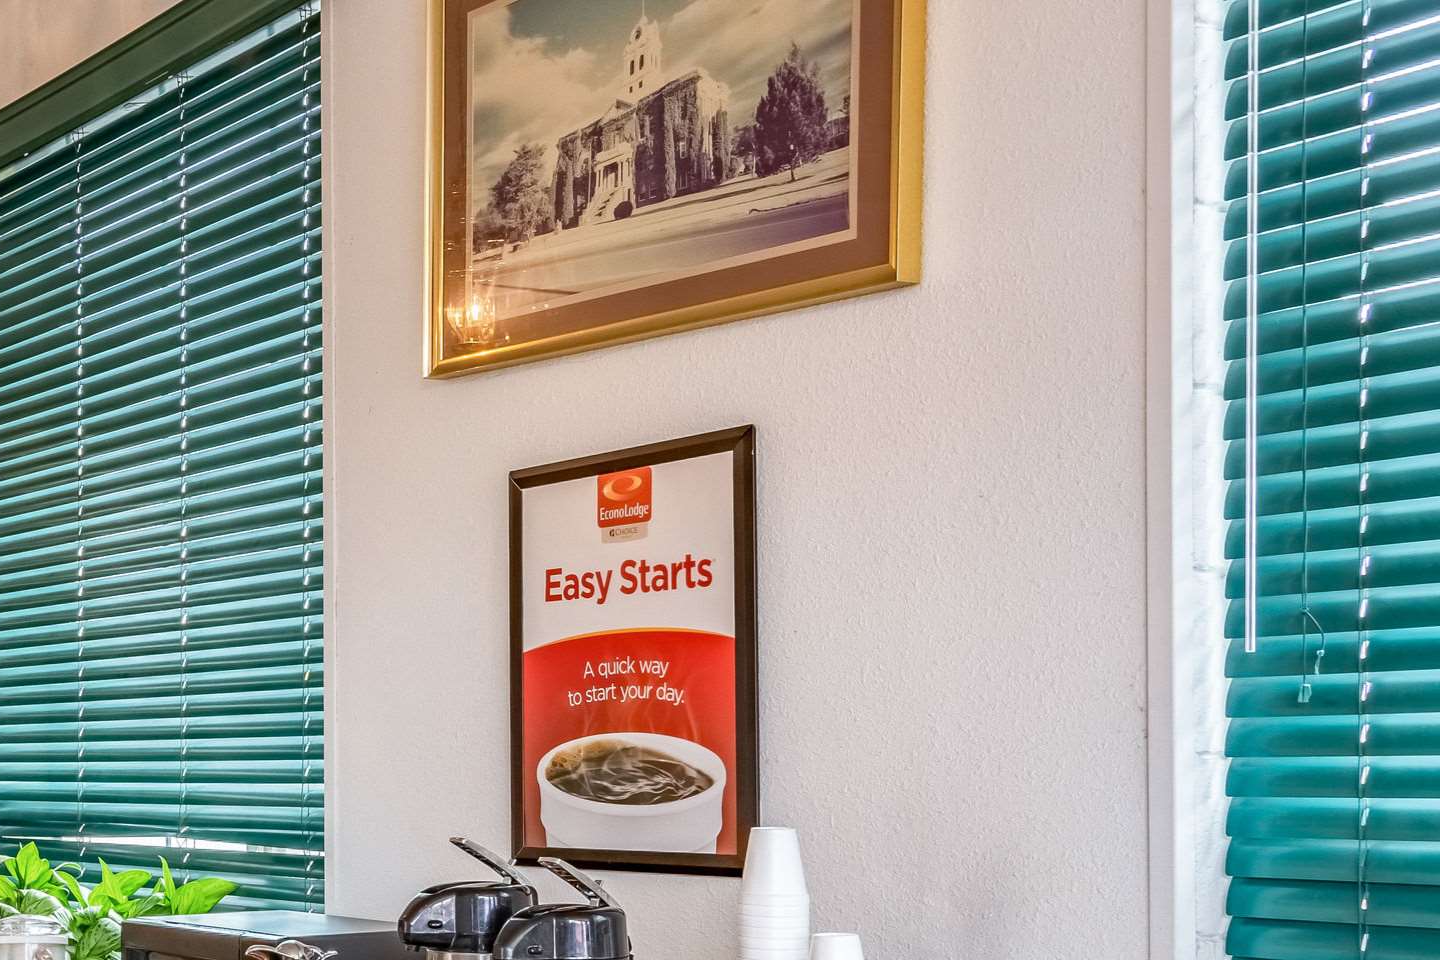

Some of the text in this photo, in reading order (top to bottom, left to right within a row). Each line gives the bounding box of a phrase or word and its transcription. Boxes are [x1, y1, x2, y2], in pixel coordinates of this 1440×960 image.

[545, 554, 713, 605] Easy Starts
[584, 656, 669, 679] A quick way
[568, 682, 685, 706] to start your day.
